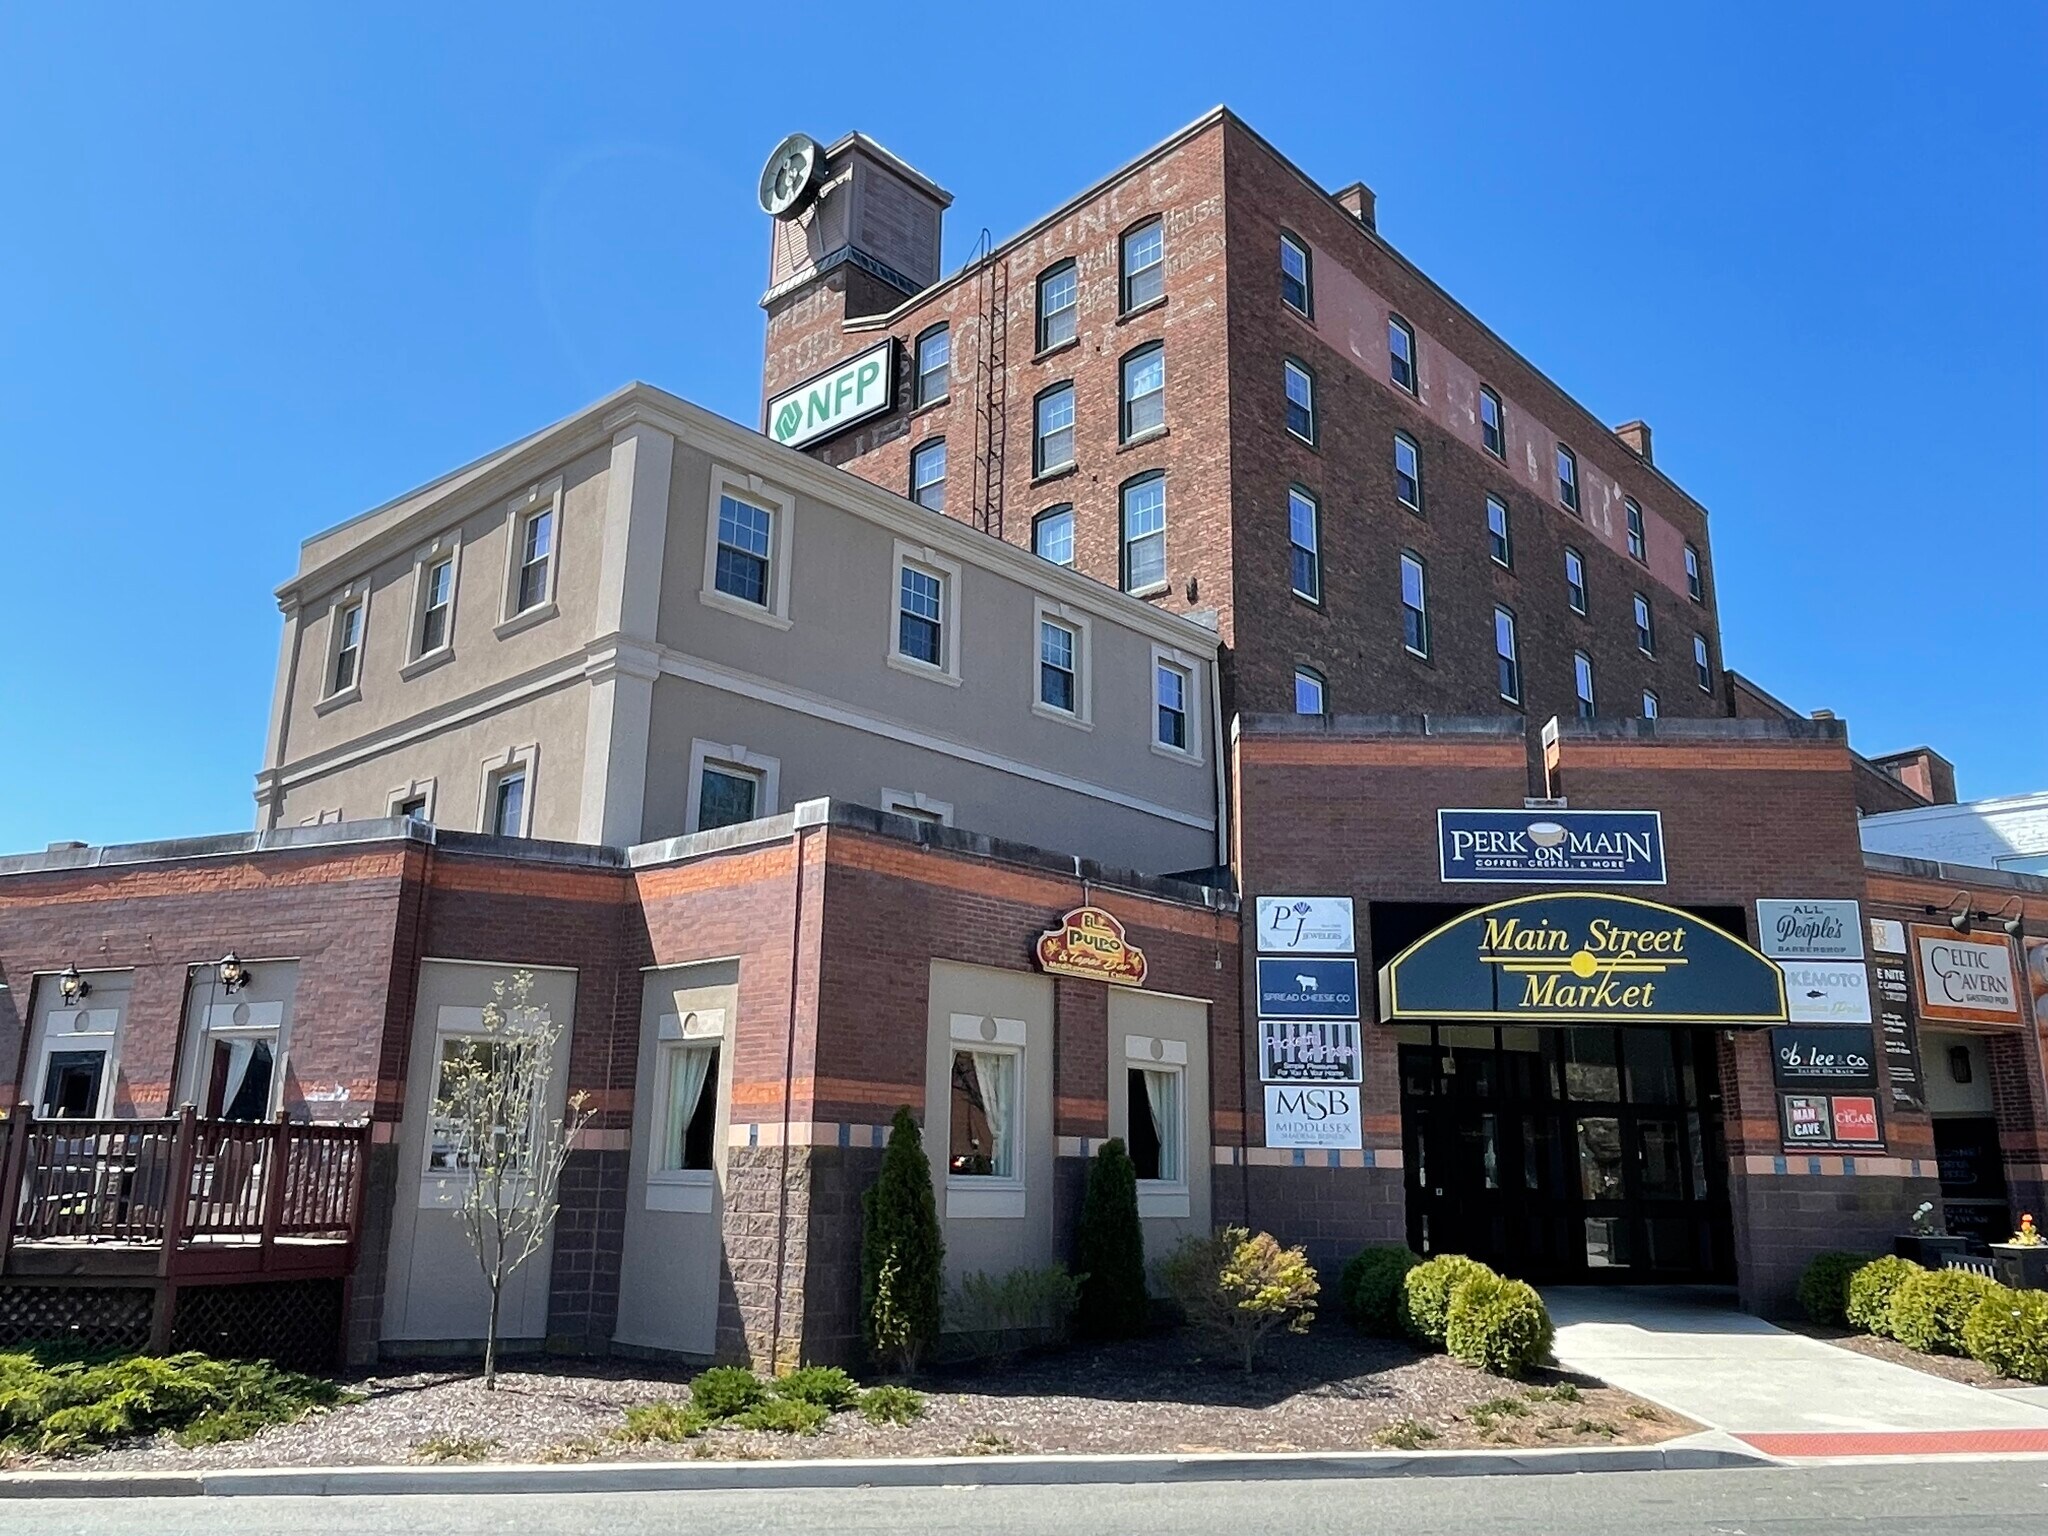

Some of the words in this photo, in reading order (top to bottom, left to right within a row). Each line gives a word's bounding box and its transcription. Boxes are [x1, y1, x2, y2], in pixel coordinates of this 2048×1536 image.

[807, 361, 880, 429] NFP
[1451, 830, 1528, 861] PERK
[1535, 846, 1564, 861] ON
[1569, 832, 1651, 863] MAIN
[1475, 859, 1523, 868] COFFEE,
[1528, 859, 1574, 868] CREPES,
[1592, 860, 1625, 869] MORE
[1793, 905, 1824, 915] ALL
[1084, 915, 1111, 931] EL
[1776, 914, 1844, 947] People's
[1069, 930, 1120, 953] PULPO
[1478, 918, 1570, 951] Main
[1583, 919, 1687, 953] Street
[1777, 945, 1847, 954] BARBERSHOP
[1058, 950, 1068, 962] &
[1102, 959, 1132, 972] Bar
[1931, 945, 1990, 980] CELTIC
[1518, 951, 1656, 1009] Market
[1942, 970, 2009, 1004] CAVERN
[1263, 992, 1300, 1002] SPREAD
[1300, 993, 1336, 1003] CHEESE
[1336, 994, 1351, 1003] CO
[1275, 1089, 1350, 1120] MSB
[1792, 1099, 1807, 1108] THE
[1793, 1108, 1816, 1121] MAN
[1835, 1112, 1875, 1124] CIGAR
[1275, 1122, 1352, 1133] MIDDLESEX
[1794, 1122, 1821, 1136] CAVE
